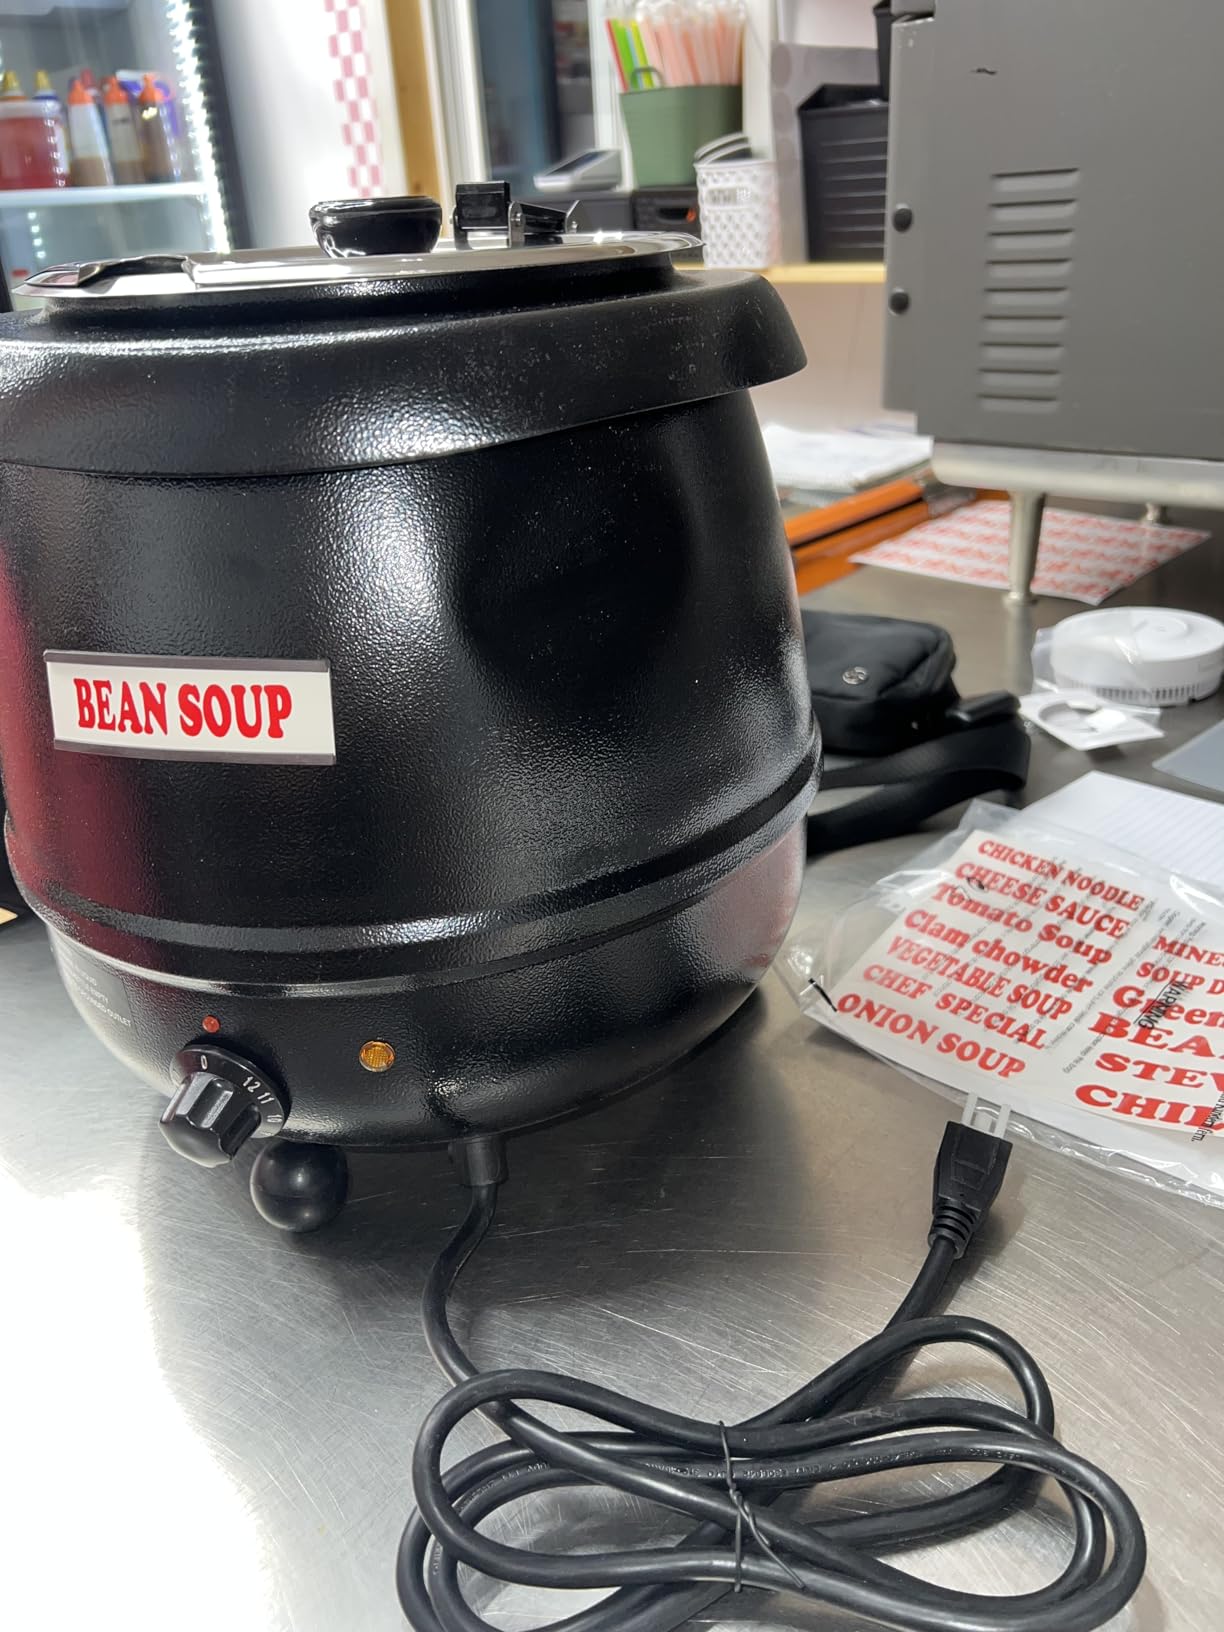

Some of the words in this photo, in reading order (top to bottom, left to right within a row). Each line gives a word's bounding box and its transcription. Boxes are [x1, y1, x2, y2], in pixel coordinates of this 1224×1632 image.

[74, 678, 167, 735] BEAN
[178, 684, 292, 738] SOUP
[955, 862, 1047, 907] CHEESE
[1045, 894, 1130, 940] SAUCE
[977, 839, 1063, 881] CHICKEN
[1061, 869, 1145, 911] NOODLE
[904, 908, 970, 948] Clam
[972, 937, 1093, 993] chowder
[931, 881, 1033, 932] Tomato
[1038, 922, 1112, 965] Soup
[1152, 935, 1224, 967] MINE
[887, 935, 1011, 998] VEGETABLE
[1007, 983, 1073, 1020] SOUP
[1136, 961, 1205, 991] SOUP
[1137, 979, 1188, 1030] WARNING
[837, 993, 939, 1044] ONION
[936, 1031, 1025, 1078] SOUP
[863, 964, 932, 999] CHEF
[935, 992, 1047, 1050] SPECIAL
[1088, 1012, 1224, 1060] BEA
[201, 1055, 208, 1070] 0
[243, 1076, 261, 1093] 12
[257, 1092, 274, 1104] 11
